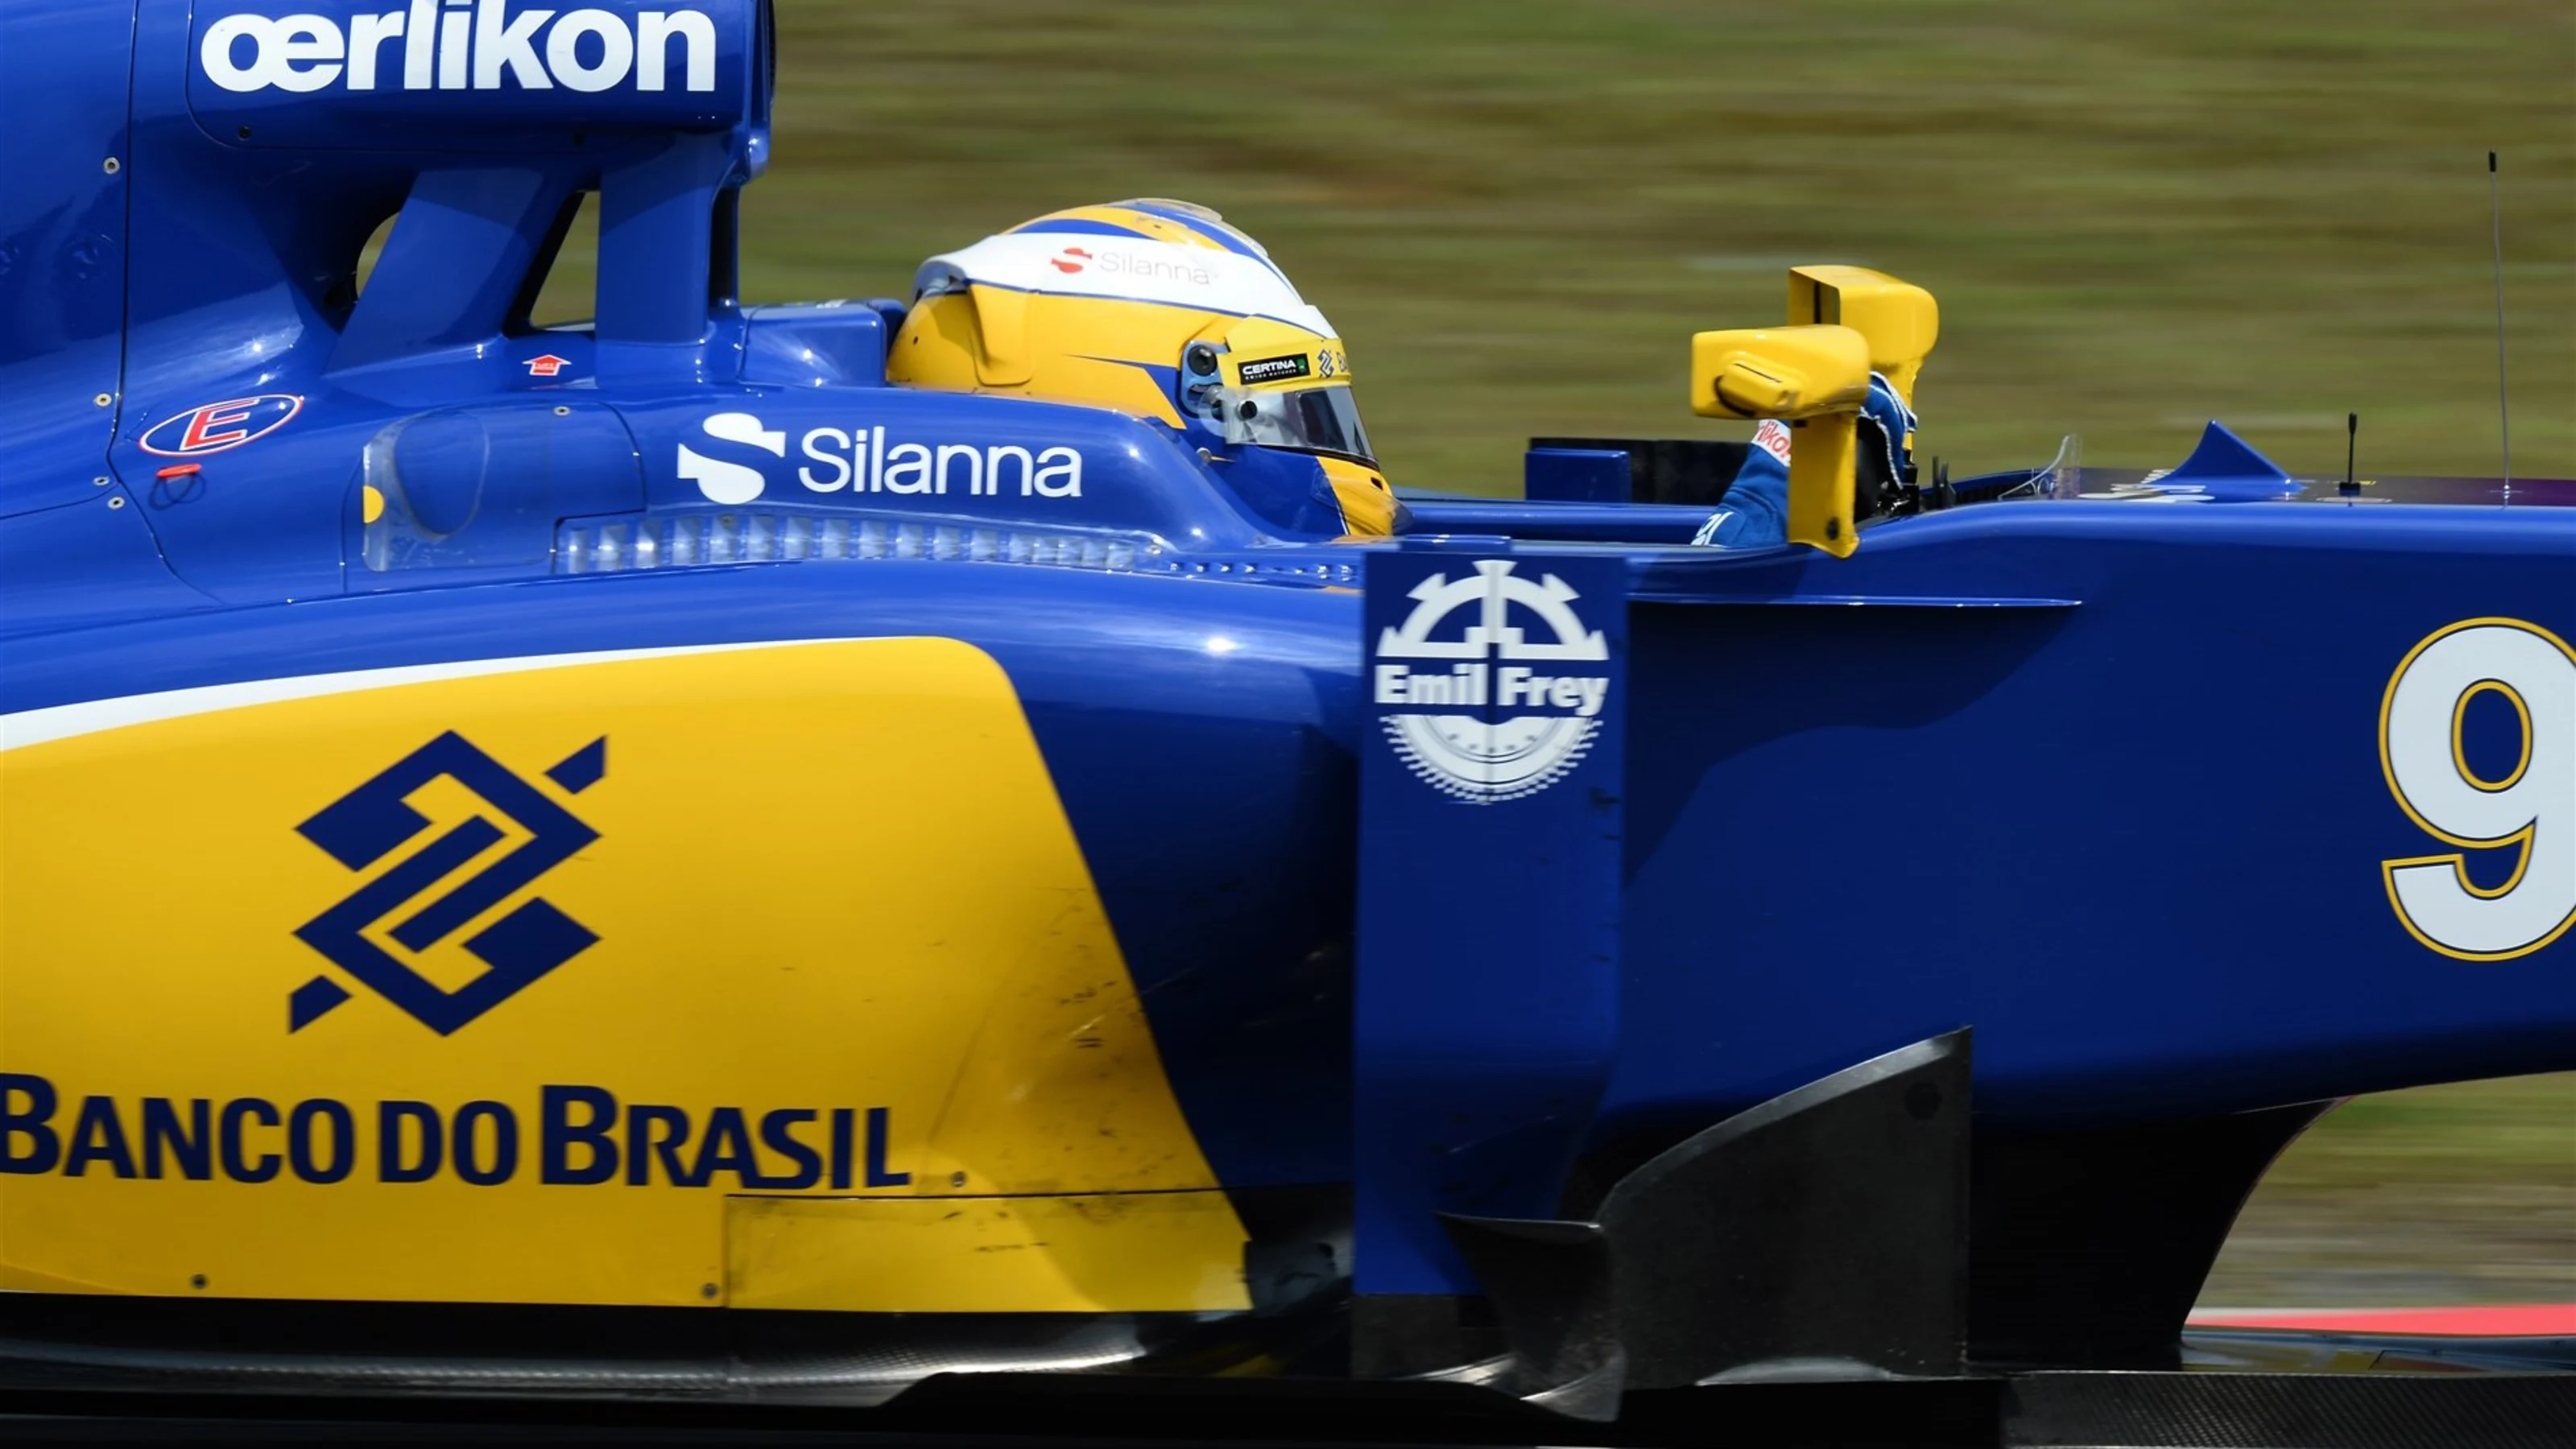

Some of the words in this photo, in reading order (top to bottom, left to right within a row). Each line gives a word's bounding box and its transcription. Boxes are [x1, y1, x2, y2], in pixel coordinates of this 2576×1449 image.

[1099, 251, 1210, 286] Silanna
[1242, 359, 1296, 375] CERTINA
[798, 426, 1082, 497] Silanna
[1375, 663, 1488, 705] Emil
[1497, 667, 1610, 716] Frey
[2378, 617, 2576, 961] 9
[0, 1072, 355, 1185] BANCO
[377, 1100, 519, 1185] DO
[540, 1084, 912, 1190] BRASIL
